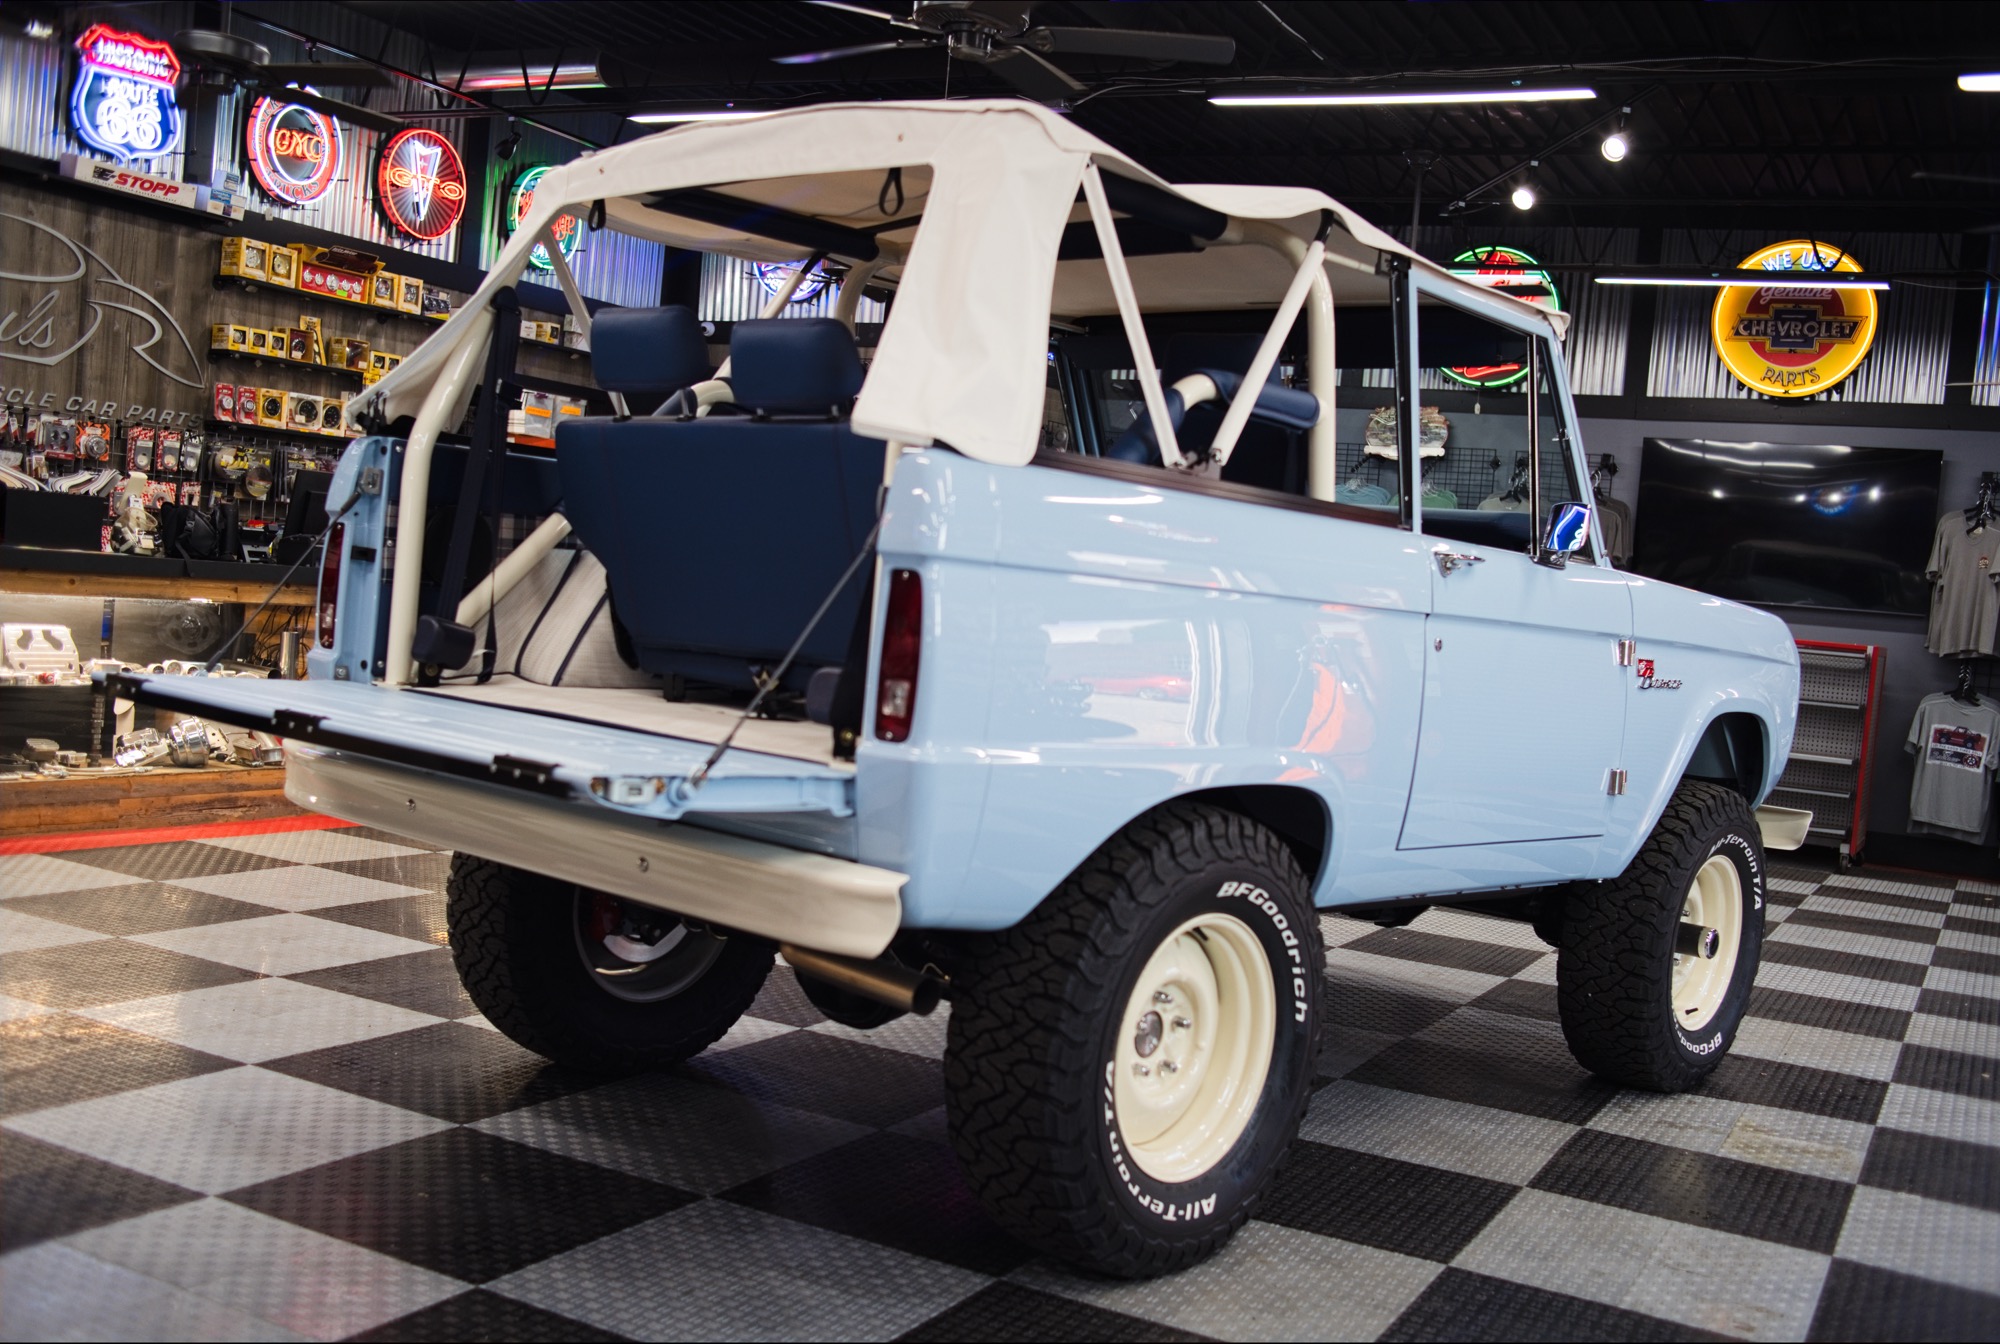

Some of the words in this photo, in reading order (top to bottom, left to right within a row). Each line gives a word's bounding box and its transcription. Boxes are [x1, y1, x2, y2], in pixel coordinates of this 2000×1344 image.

[96, 37, 170, 77] HISTORIC
[101, 77, 159, 107] ROUTE
[96, 98, 162, 150] 66
[275, 128, 323, 163] GMC
[1761, 251, 1793, 272] WE
[1737, 320, 1854, 337] CHEVROLET
[1760, 366, 1821, 388] PARTS
[0, 386, 57, 407] CLE
[66, 396, 118, 416] CAR
[125, 404, 204, 428] PARTS
[1753, 874, 1762, 910] T/A
[1216, 881, 1308, 1022] BFGoodrich
[1109, 1130, 1217, 1221] All-Terrain
